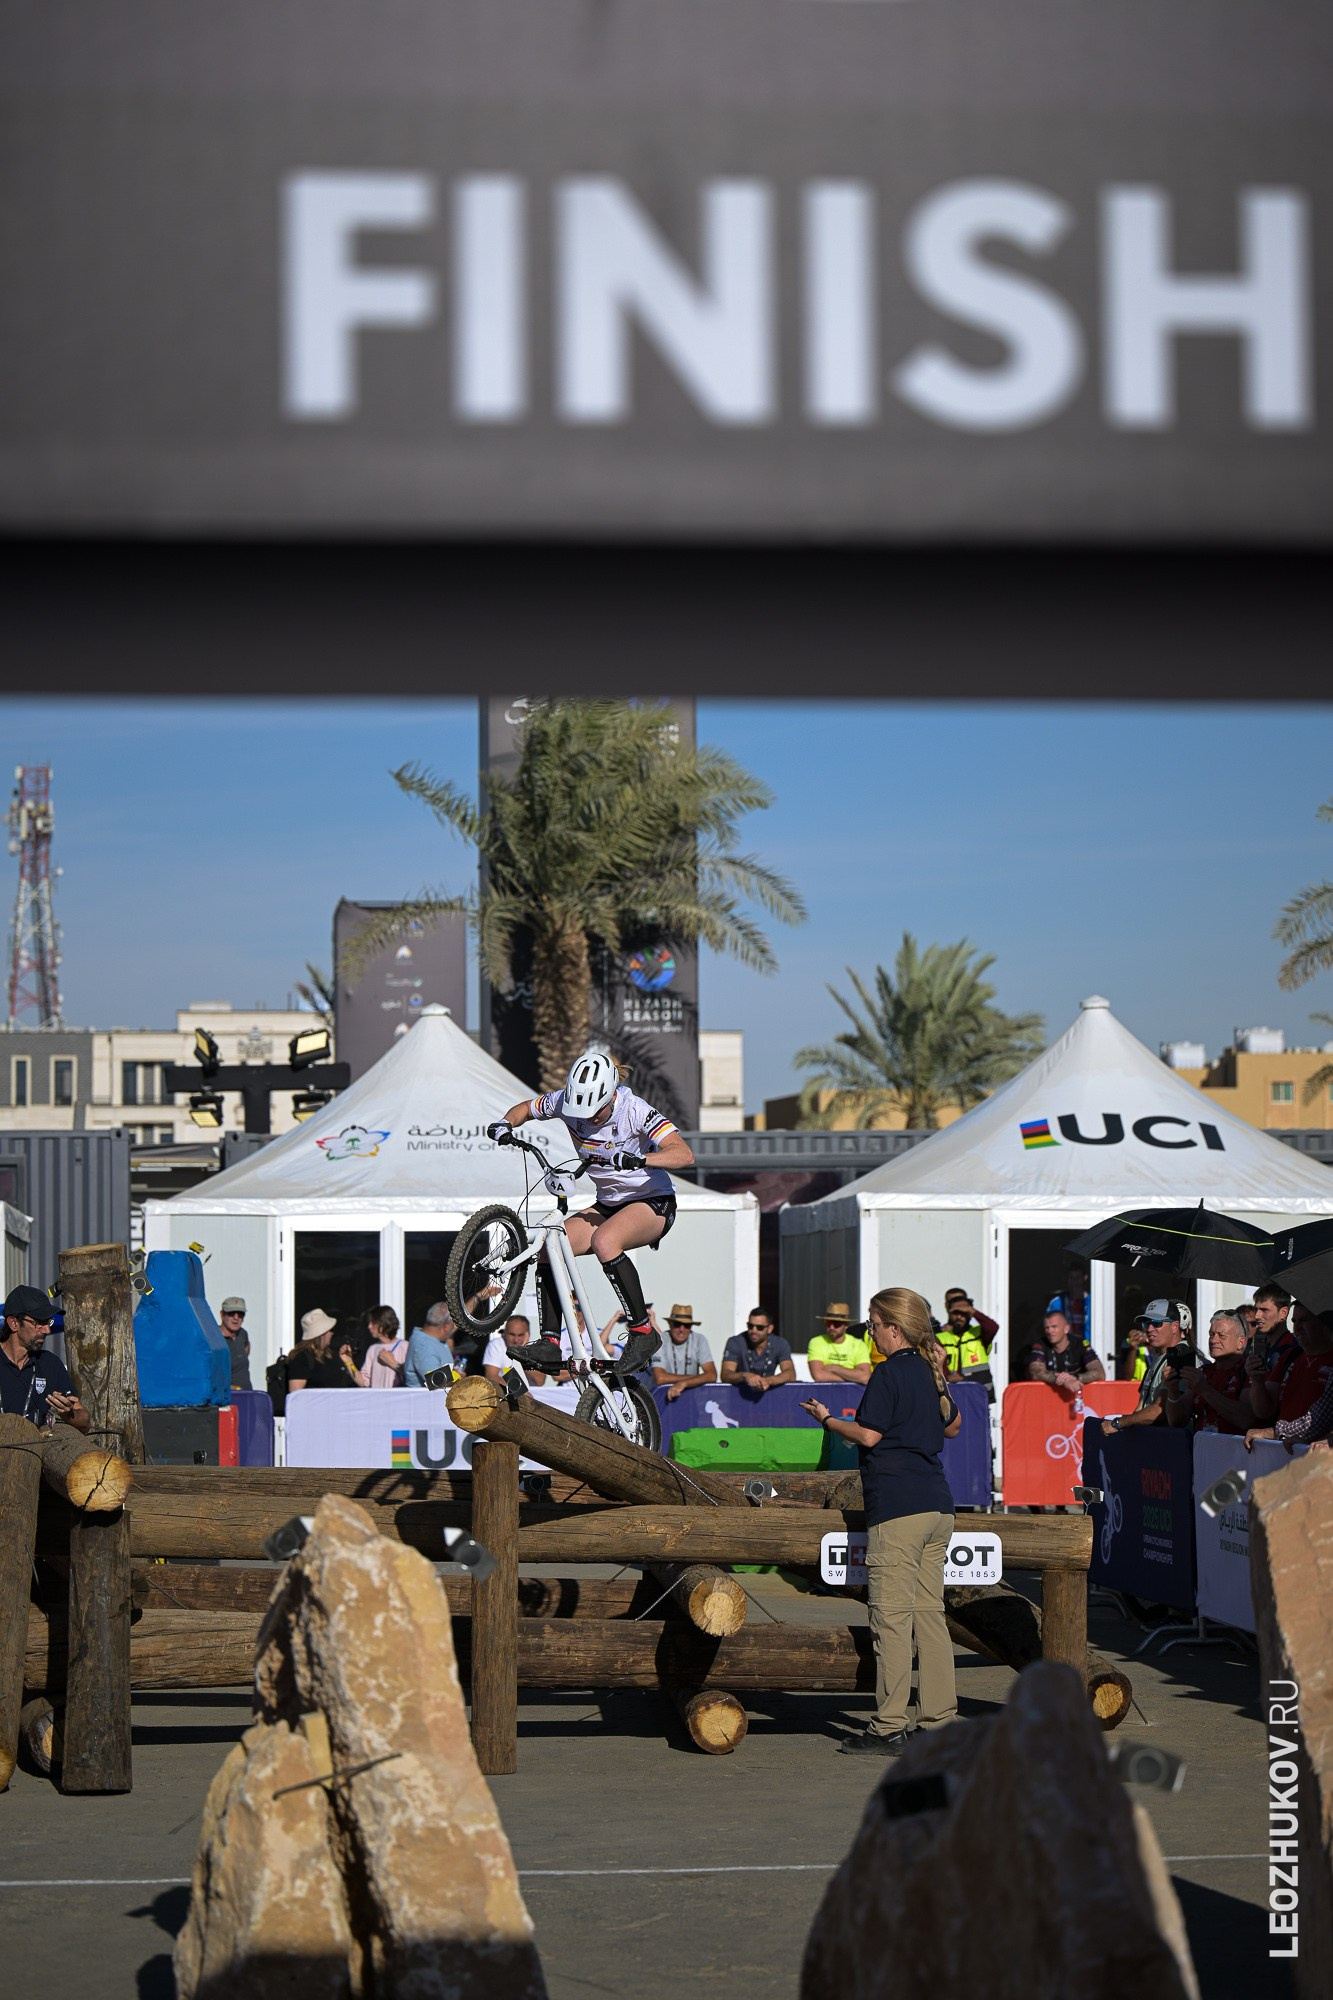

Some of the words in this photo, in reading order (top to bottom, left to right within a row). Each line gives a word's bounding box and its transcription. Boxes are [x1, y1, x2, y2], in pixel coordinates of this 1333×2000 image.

[283, 171, 1312, 431] FINISH
[624, 1010, 682, 1021] SEASON
[1057, 1113, 1225, 1151] UCI
[407, 1140, 473, 1151] Ministry
[478, 1141, 496, 1151] of
[550, 1181, 565, 1192] 4A
[1141, 1468, 1171, 1500] RIYADH
[970, 1570, 996, 1578] 1853
